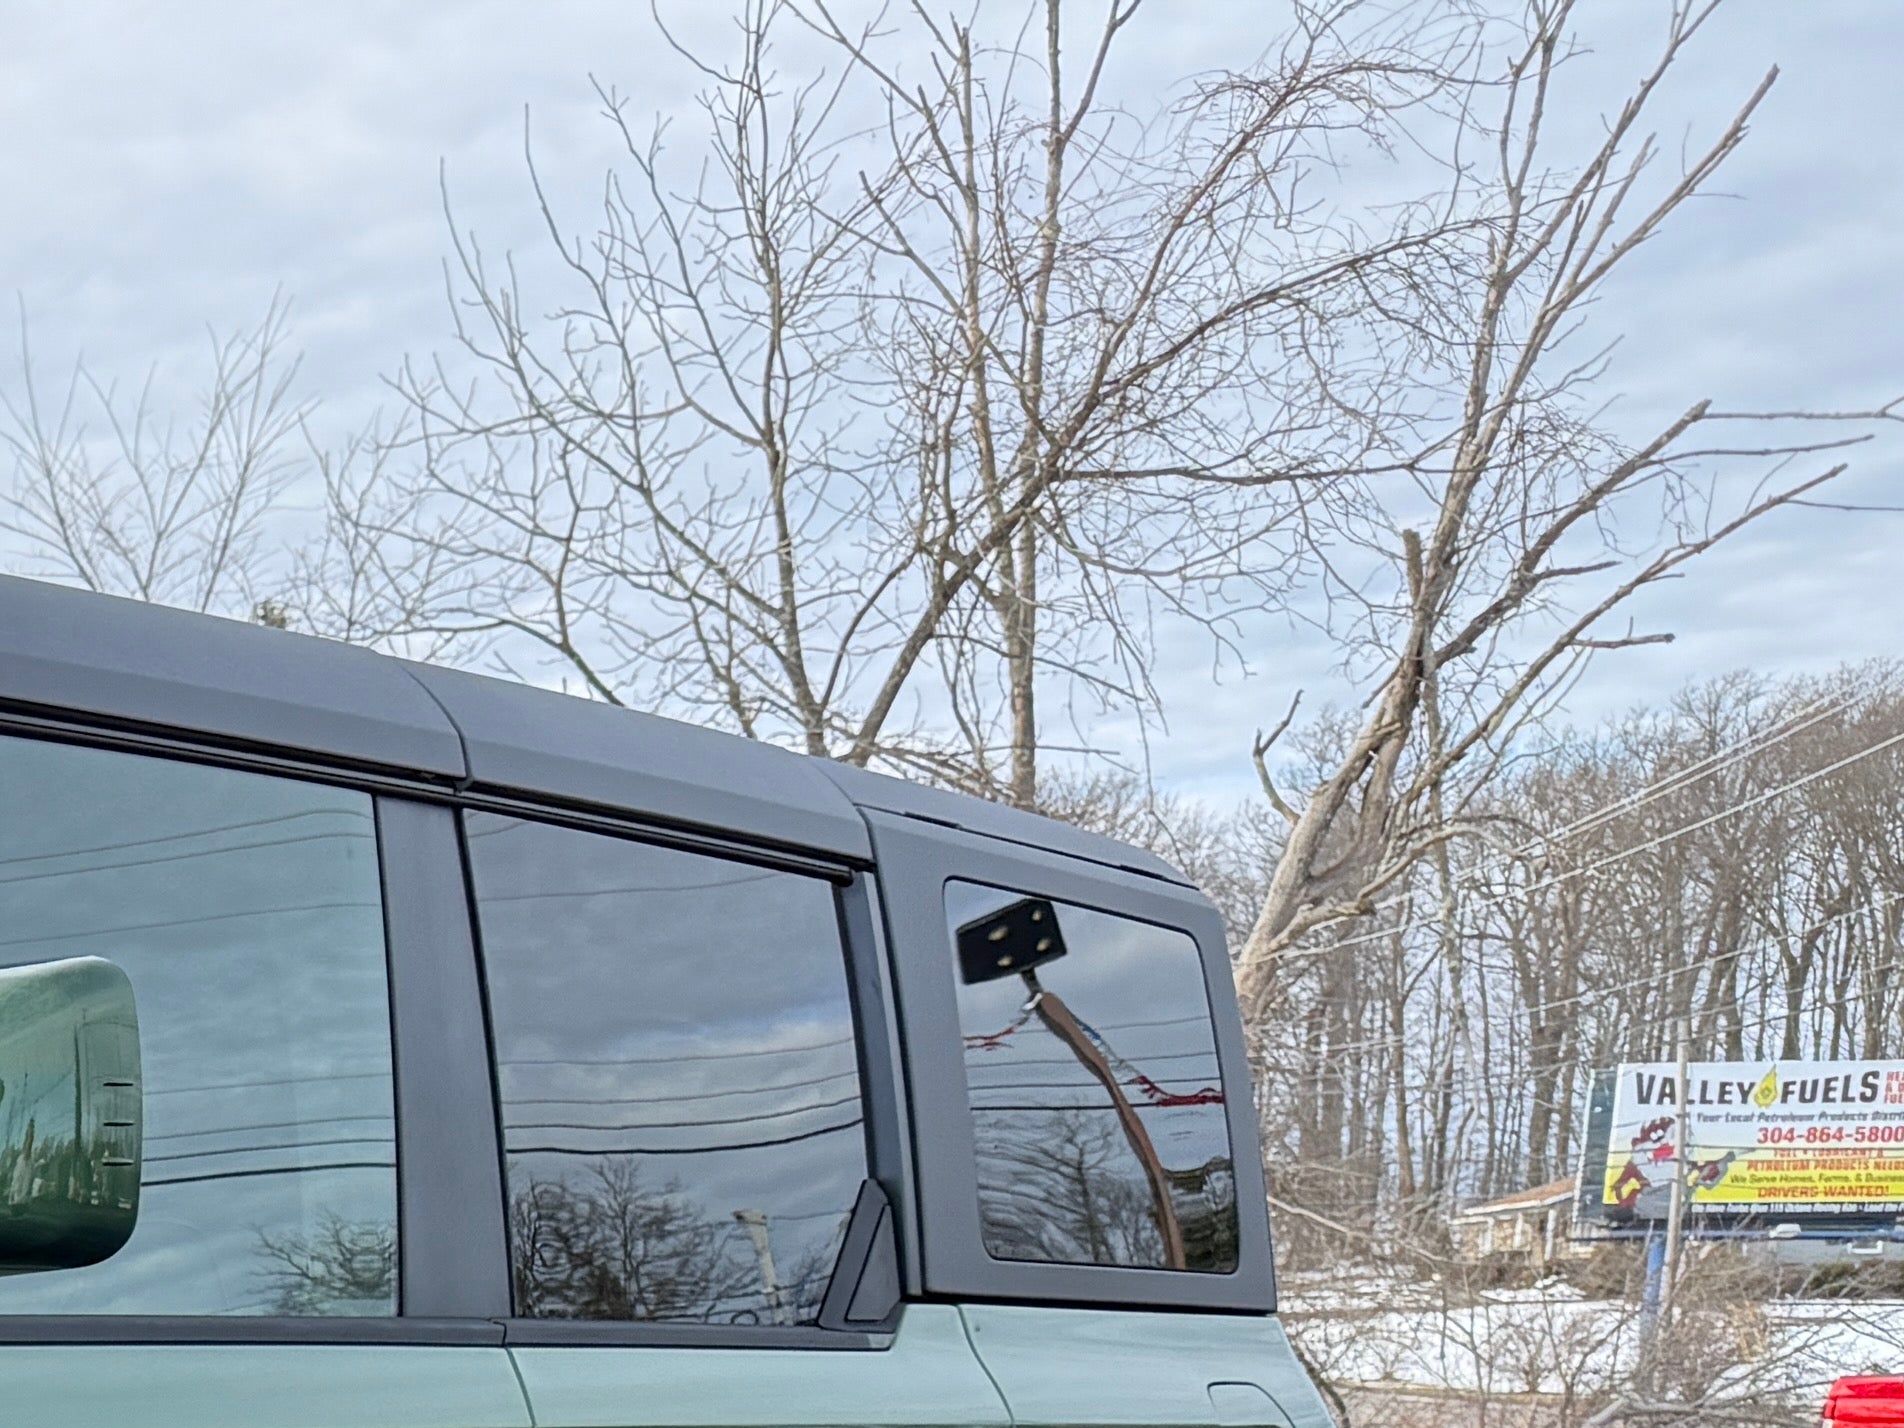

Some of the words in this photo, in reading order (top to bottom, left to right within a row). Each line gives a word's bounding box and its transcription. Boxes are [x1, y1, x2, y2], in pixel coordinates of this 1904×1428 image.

[1780, 1070, 1880, 1104] FUELS
[1757, 1111, 1815, 1123] Petroleum
[1819, 1111, 1868, 1122] Products
[1757, 1126, 1904, 1144] 304-864-5800
[1747, 1160, 1809, 1171] PETROLEUM
[1814, 1159, 1870, 1171] PRODUCTS
[1758, 1186, 1819, 1198] DRIVERS
[1823, 1185, 1889, 1198] WANTED!
